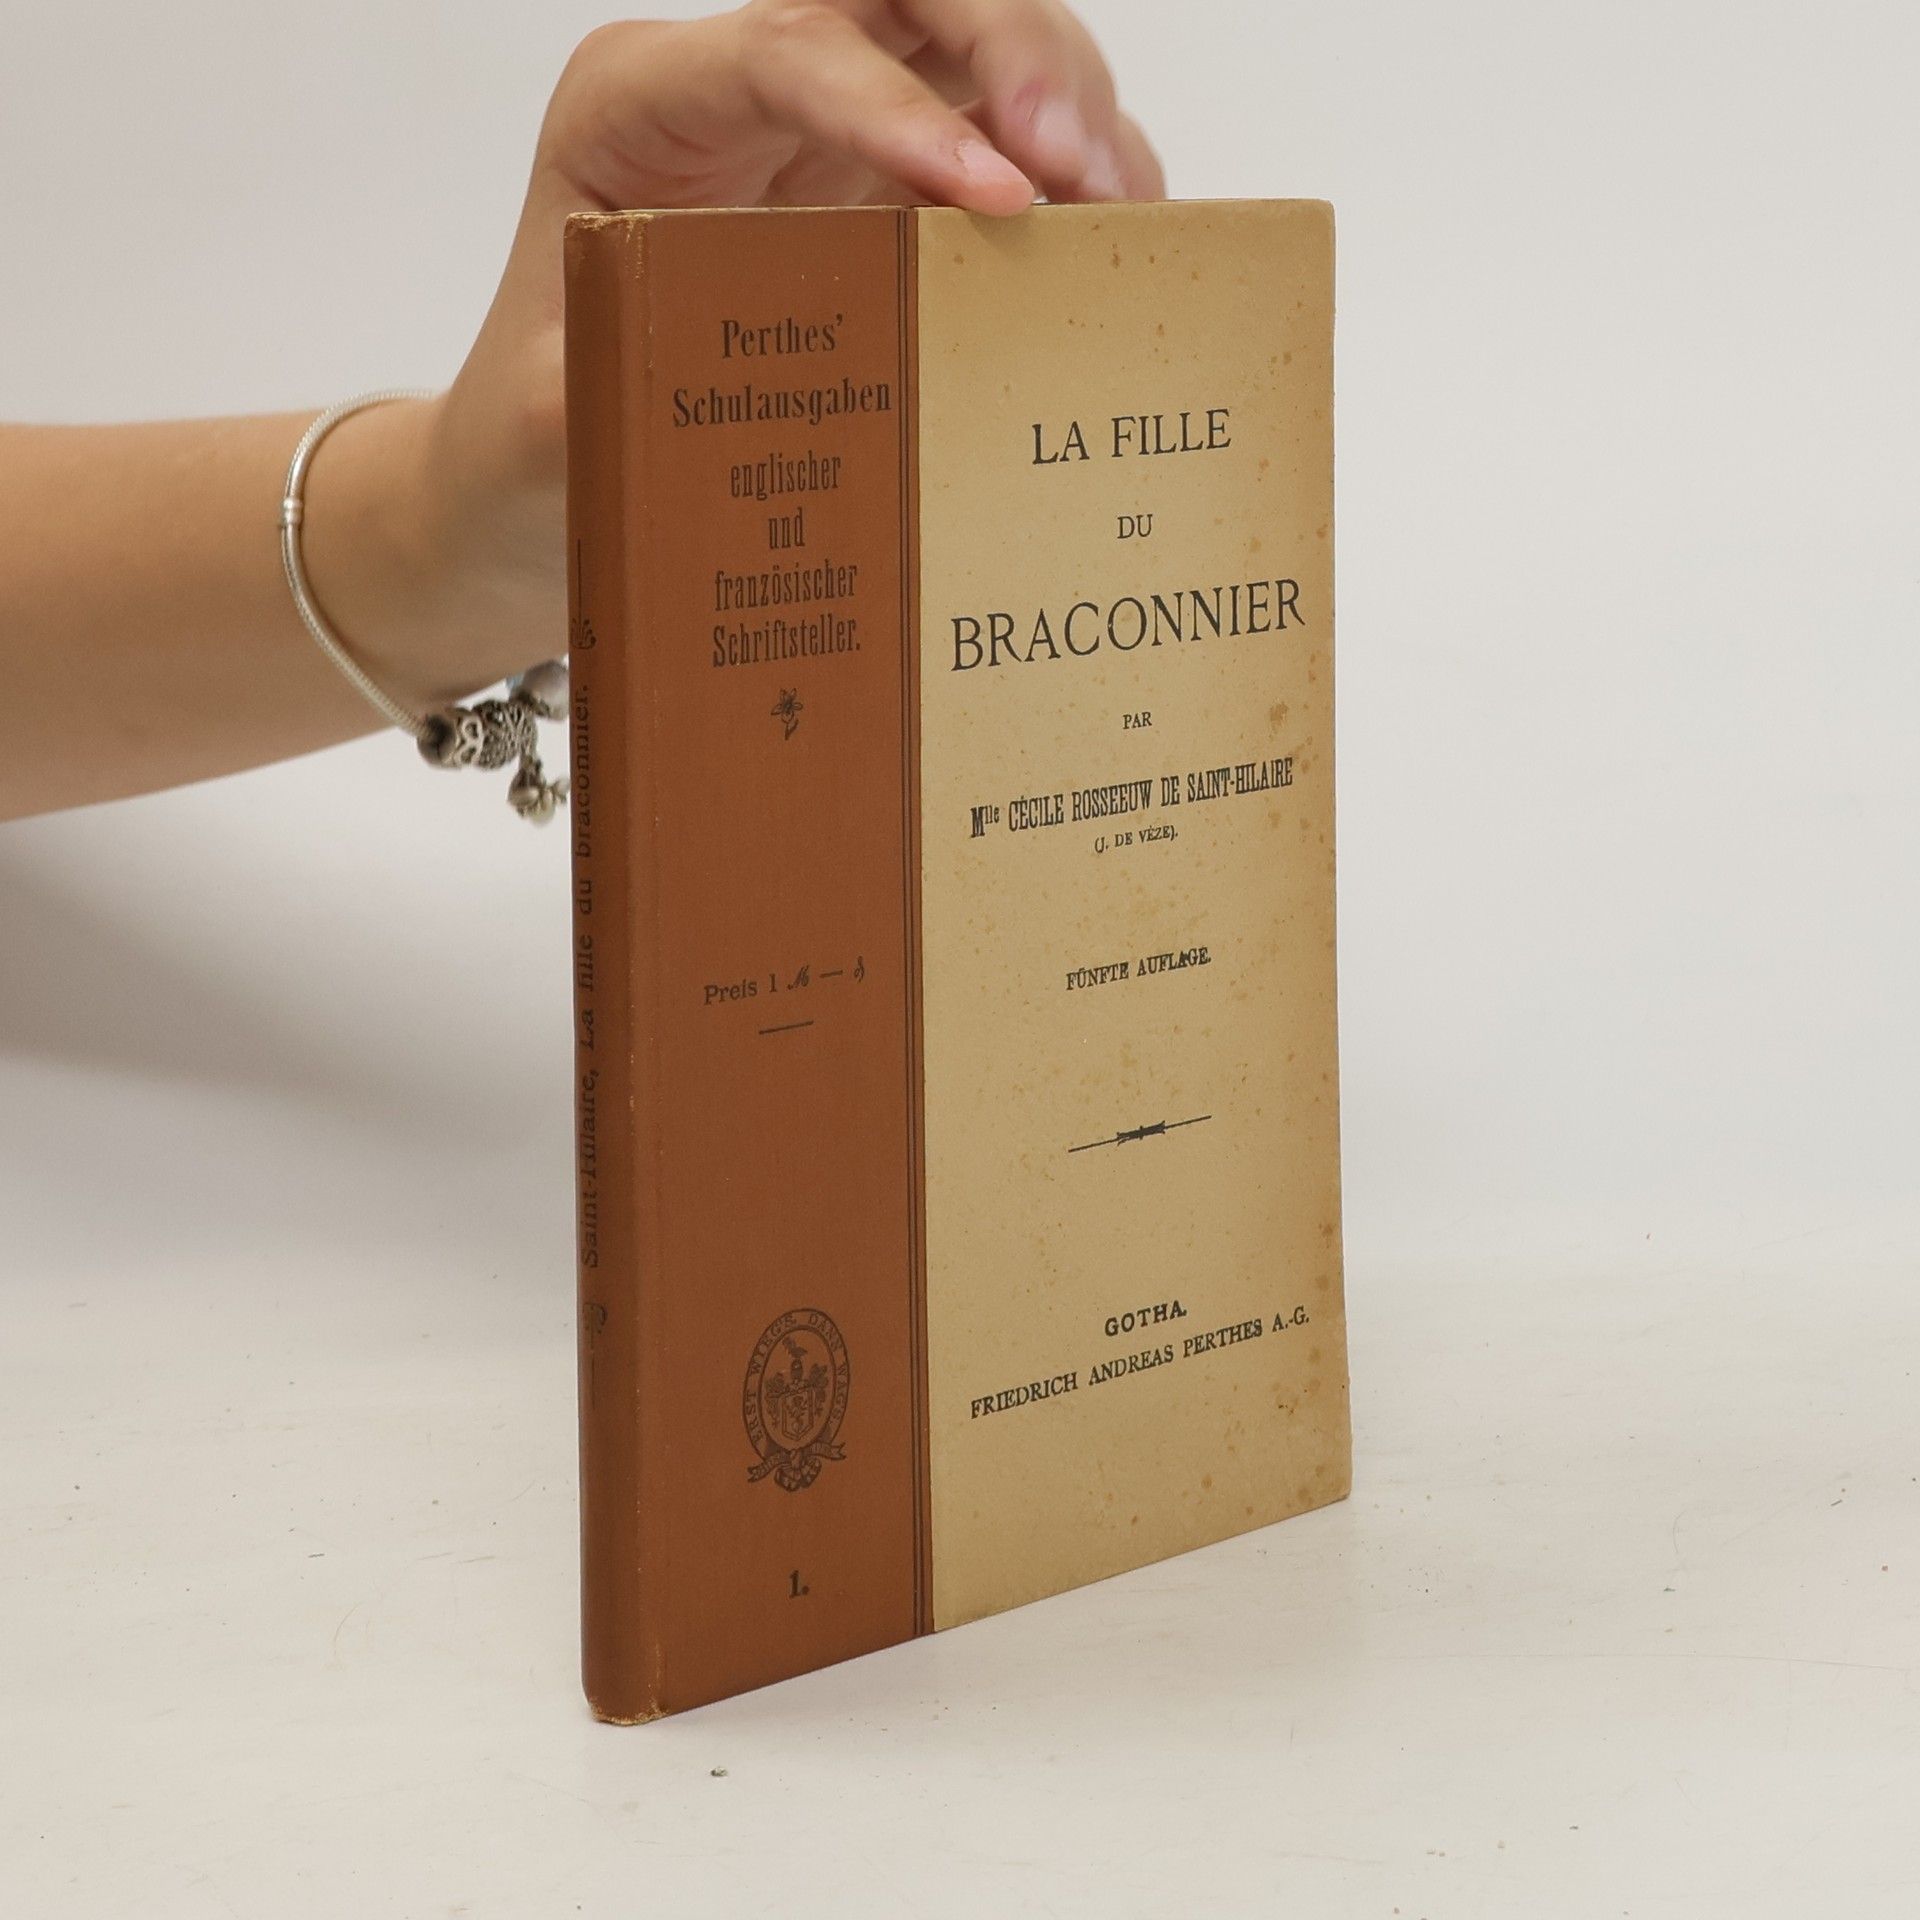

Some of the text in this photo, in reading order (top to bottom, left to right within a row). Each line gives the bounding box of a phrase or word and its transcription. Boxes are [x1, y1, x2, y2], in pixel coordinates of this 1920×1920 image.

[672, 378, 892, 428] Schulausgaben
[1031, 408, 1232, 465] LA FILLE
[730, 449, 842, 500] englischer
[768, 507, 806, 549] und
[1116, 514, 1154, 539] DU
[714, 558, 858, 611] französischer
[712, 613, 861, 668] Schriftsteller.
[950, 578, 1306, 672] BRACONNIER
[1122, 711, 1153, 730] PAR
[1008, 793, 1065, 832] CÉCILE
[1071, 779, 1154, 822] ROSSEEUW
[1160, 775, 1181, 807] DE
[1187, 757, 1294, 803] SAINT-HILAIRE
[1114, 831, 1133, 848] DE
[579, 879, 593, 916] du
[1066, 947, 1212, 990] FÜNFTE AUFLAGE.
[704, 979, 758, 1006] Preis
[1104, 1300, 1188, 1337] GOTHA.
[970, 1304, 1311, 1419] FRIEDRICH ANDREAS PERTHES A.-G.
[788, 1569, 811, 1600] 1.
